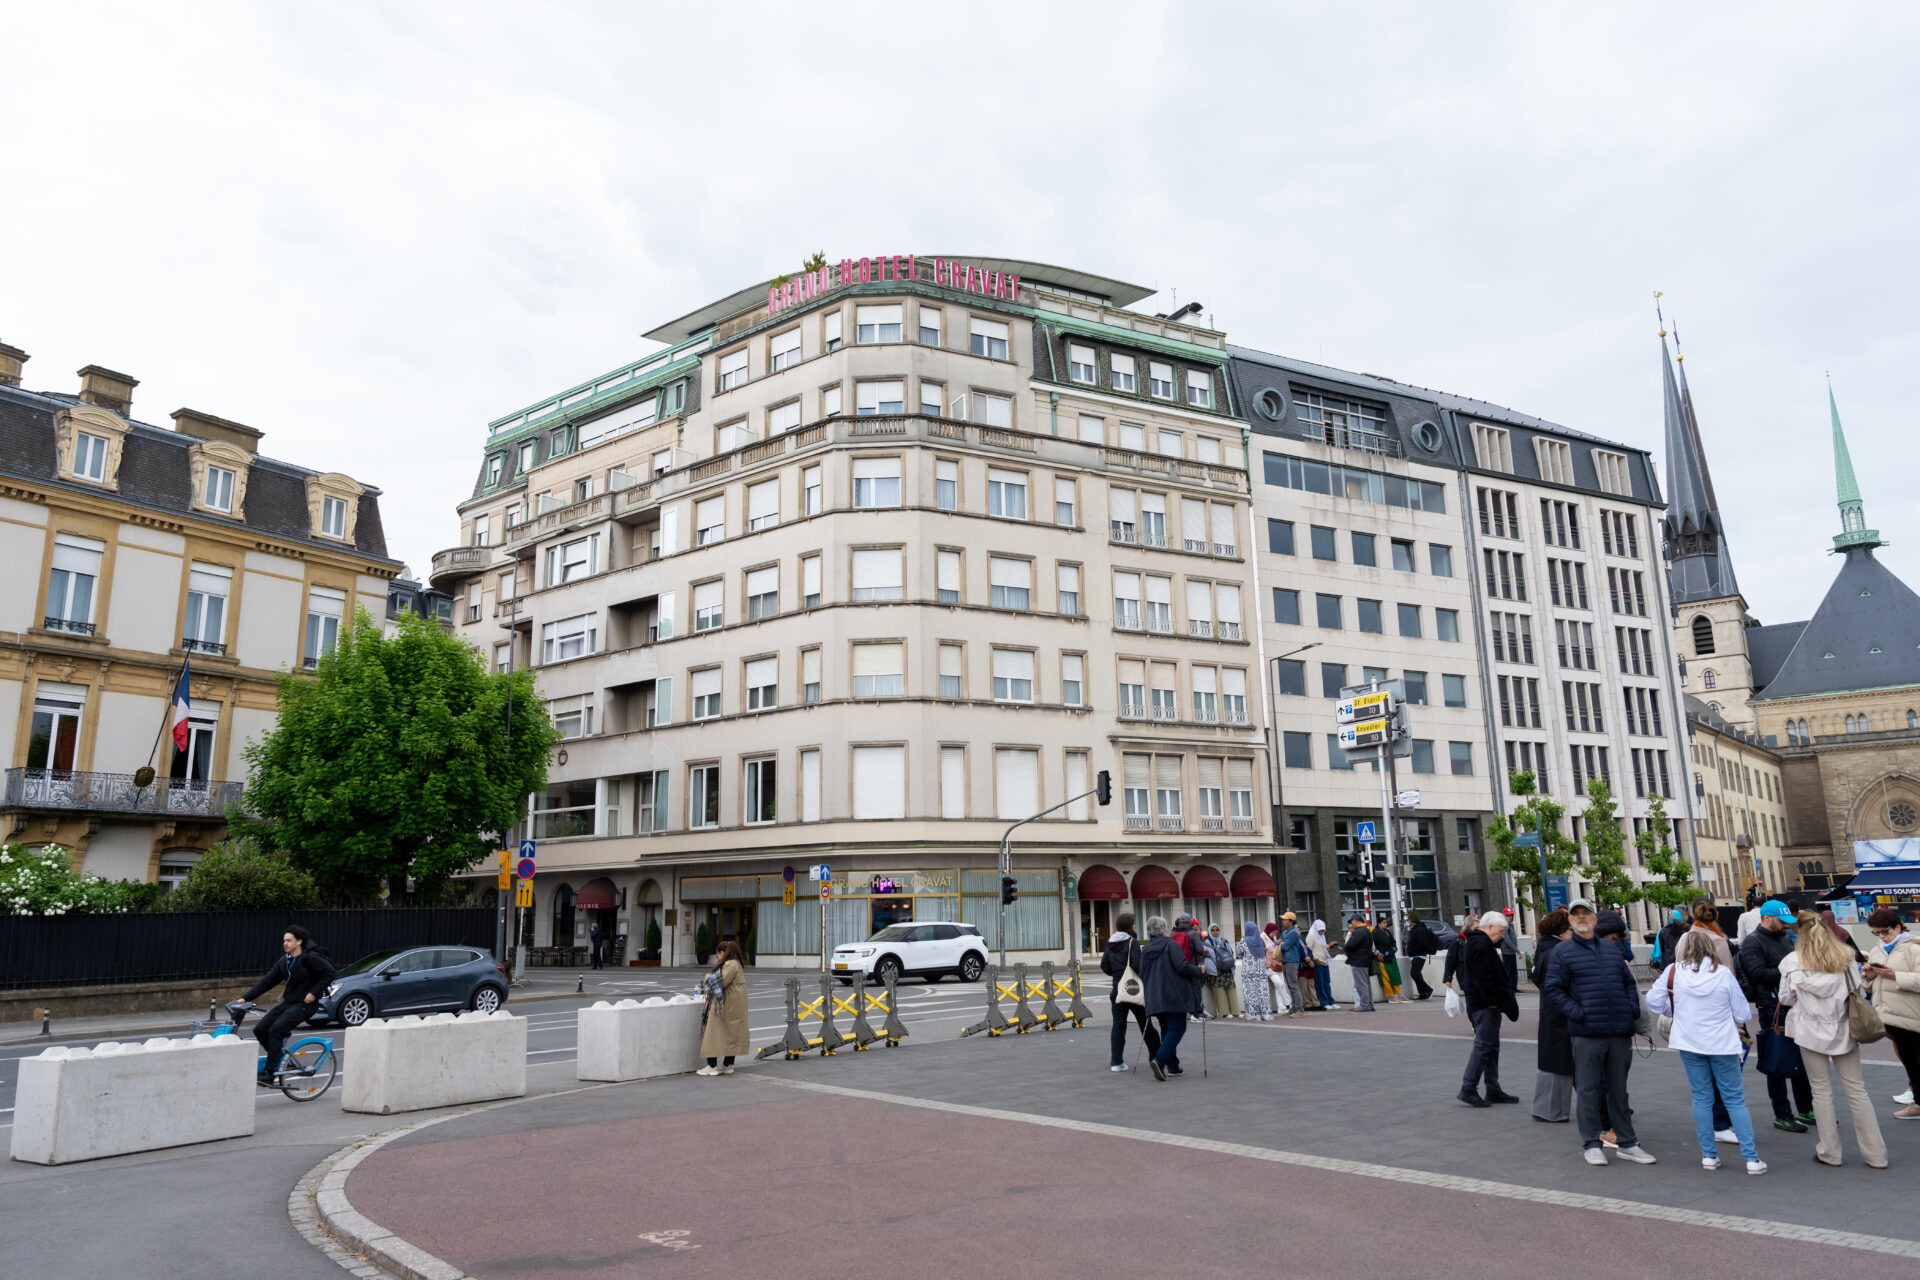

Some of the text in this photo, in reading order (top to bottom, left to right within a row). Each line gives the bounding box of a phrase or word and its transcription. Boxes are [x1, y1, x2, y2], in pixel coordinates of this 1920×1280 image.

[768, 254, 1020, 315] GRAND HOTEL CRAVAT
[1364, 695, 1381, 704] Esprit
[1356, 723, 1381, 731] Knuedler
[830, 876, 952, 889] GRAND HOTEL CRAVAT
